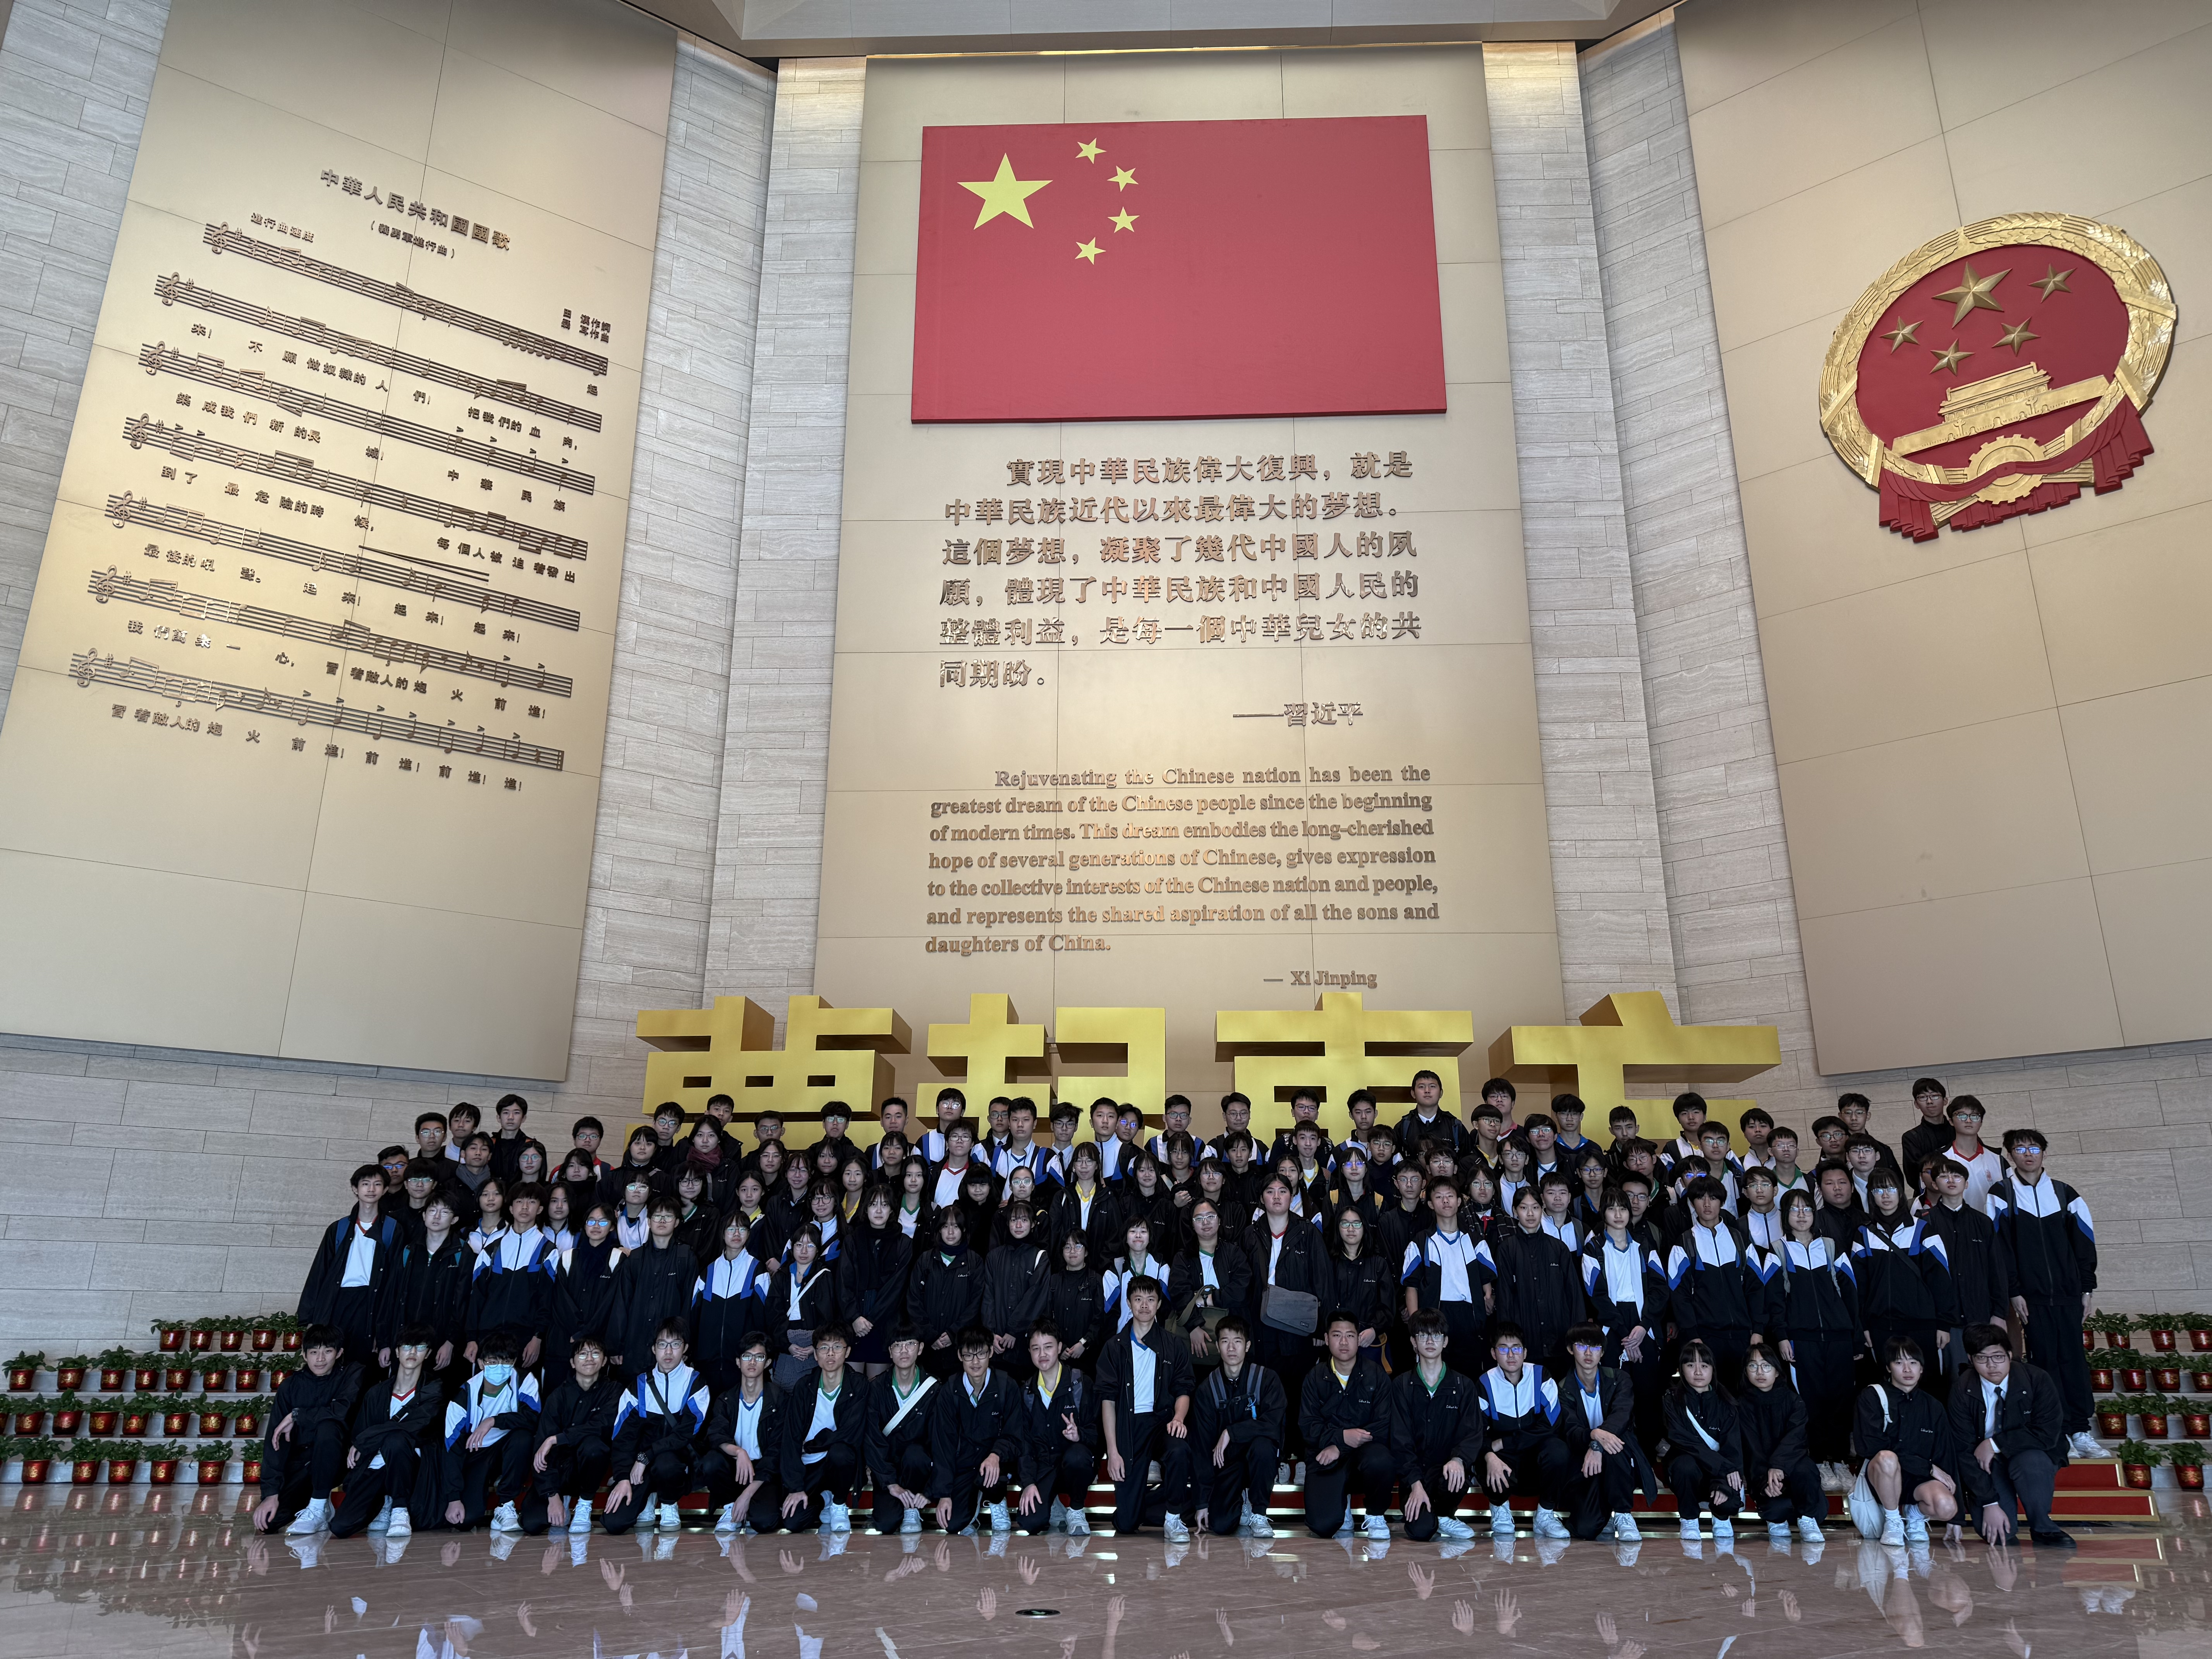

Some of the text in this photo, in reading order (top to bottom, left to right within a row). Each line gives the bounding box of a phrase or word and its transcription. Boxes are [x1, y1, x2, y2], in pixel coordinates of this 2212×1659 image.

[321, 169, 510, 250] 中華人民共和國國歌
[994, 765, 1430, 790] Rejuvenating the Chinese nation has been the
[931, 792, 1432, 817] greatest dream of the Chinese people since the beginning
[930, 819, 1434, 841] of modern times. This dream embodies the long-cherished
[929, 847, 1436, 872] hope of several generations of Chinese, gives expression
[927, 875, 1437, 896] to the collective interests of the Chinese nation and people,
[927, 903, 1439, 928] and represents the shared aspiration of all the sons and
[926, 933, 1110, 957] daughters of China.
[1291, 971, 1311, 986] Xi
[1314, 969, 1377, 989] Jinping
